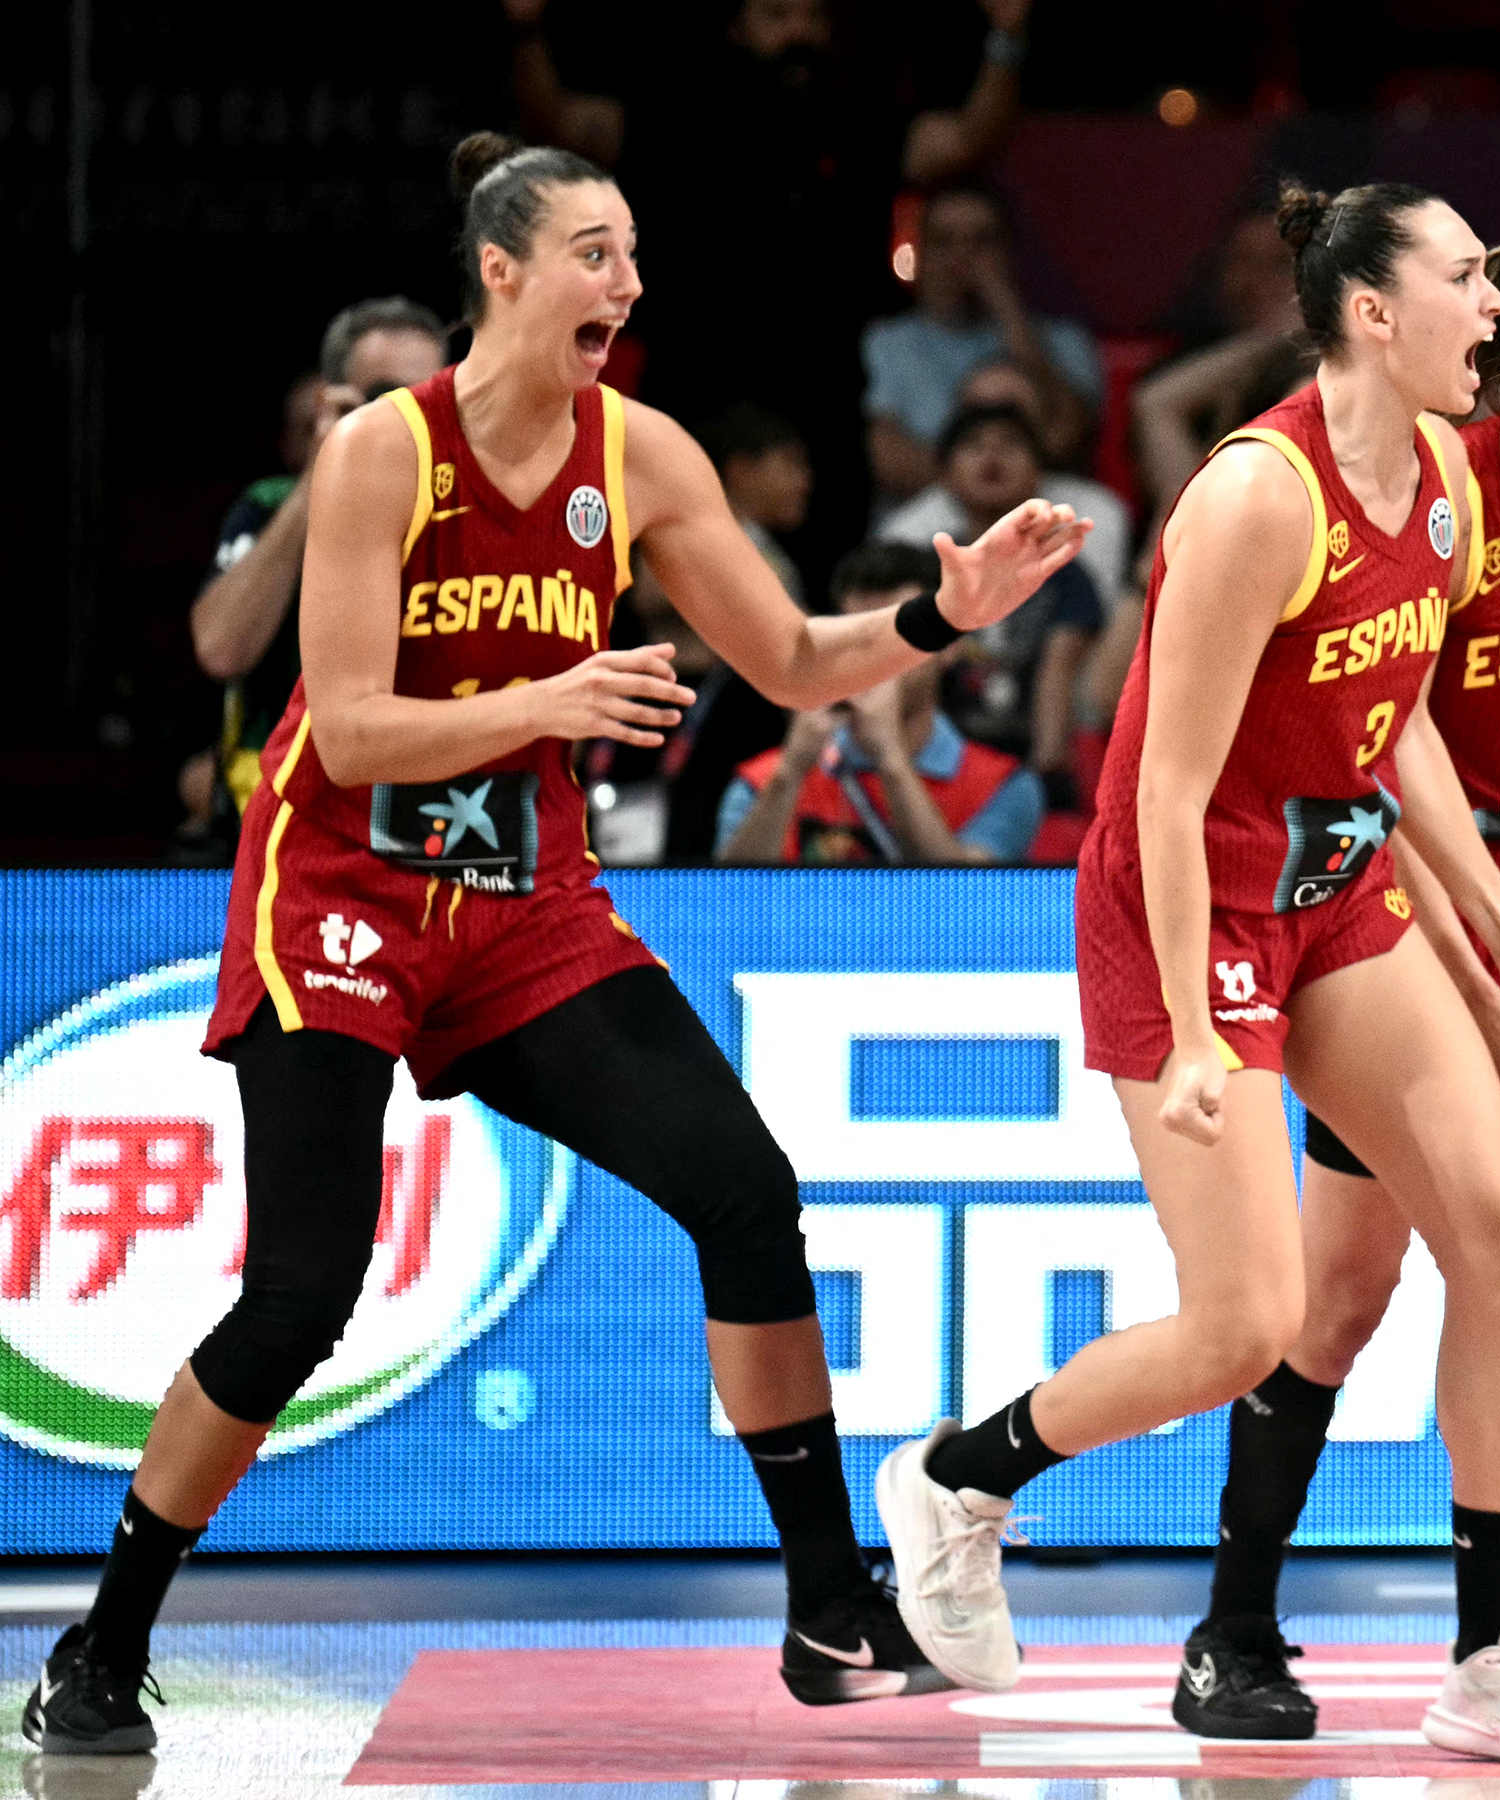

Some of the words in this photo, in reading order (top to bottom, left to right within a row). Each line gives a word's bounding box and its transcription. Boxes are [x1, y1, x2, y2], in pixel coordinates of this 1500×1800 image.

[401, 568, 600, 652] ESPAÑA
[1308, 586, 1449, 684] ESPAÑ
[1356, 700, 1396, 768] 3
